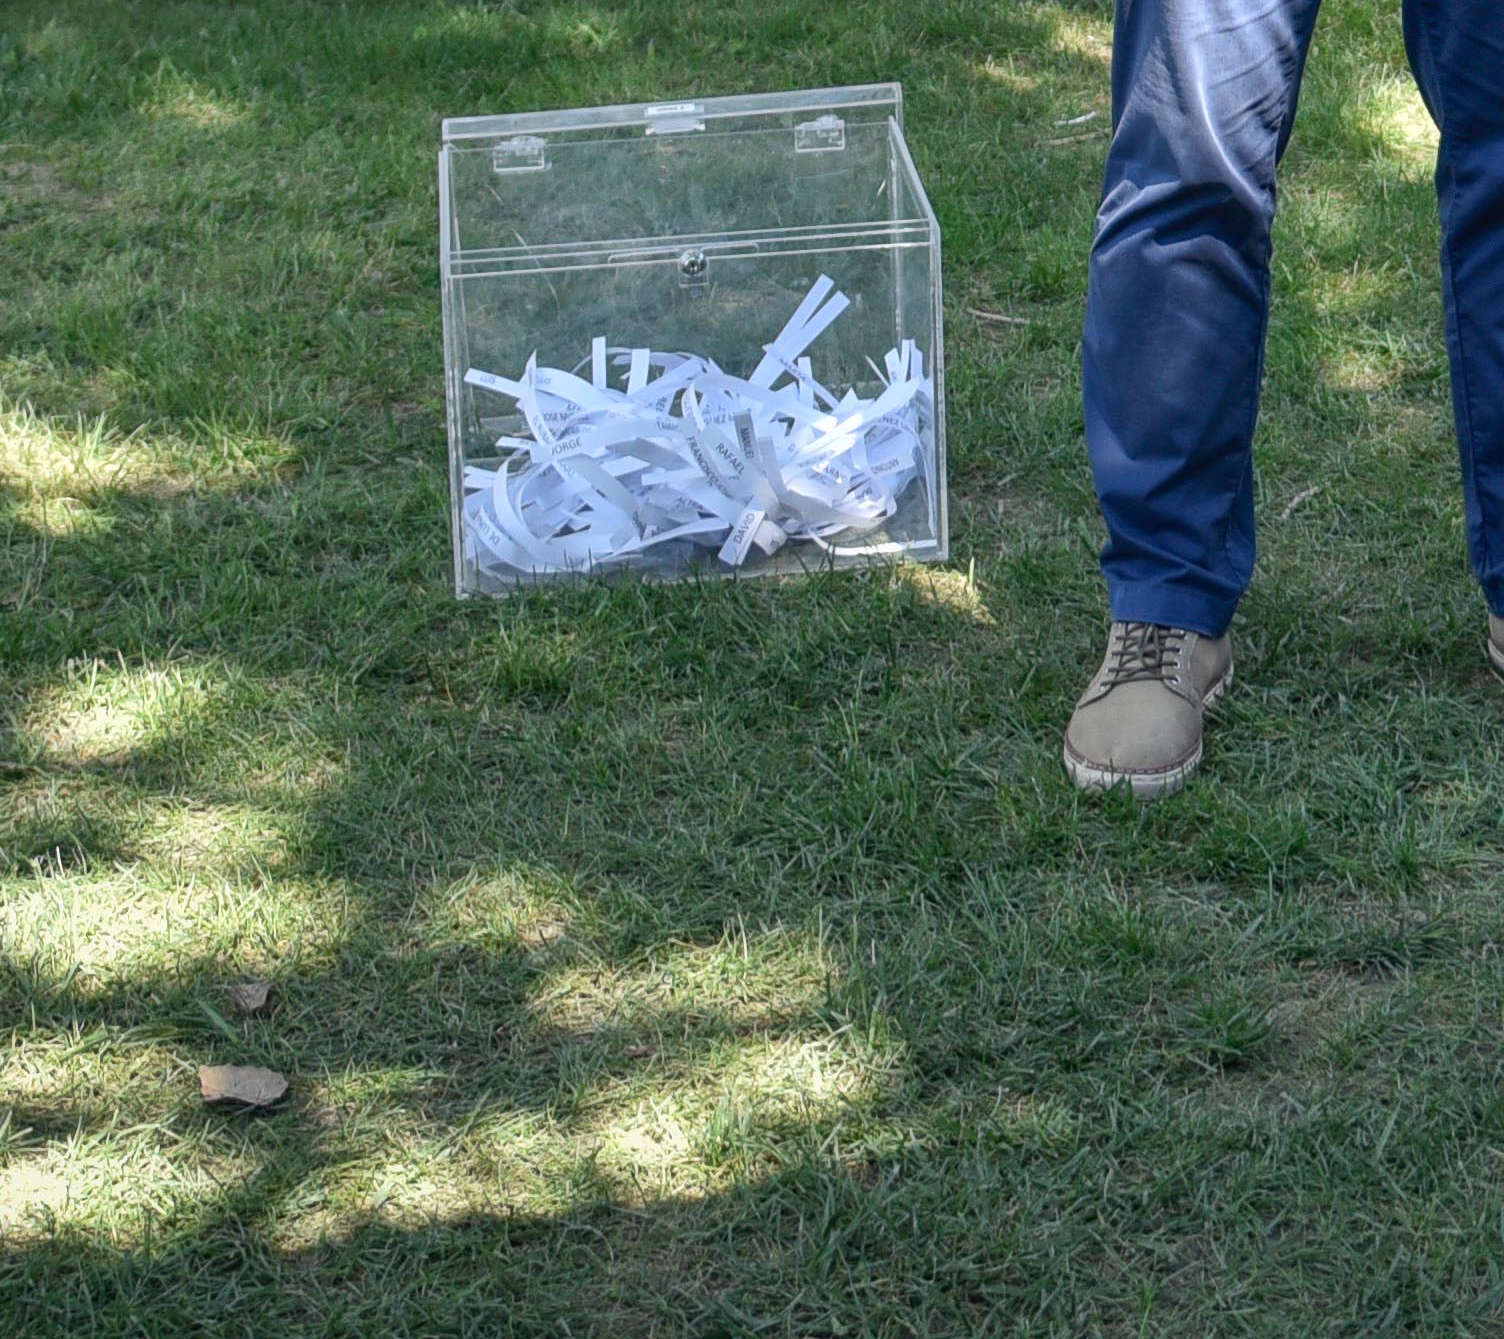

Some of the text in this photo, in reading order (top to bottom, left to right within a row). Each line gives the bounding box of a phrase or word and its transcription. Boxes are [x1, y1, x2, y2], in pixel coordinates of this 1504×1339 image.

[551, 437, 583, 456] JORGE
[715, 442, 745, 475] RAFAEL
[733, 512, 757, 544] DAVID
